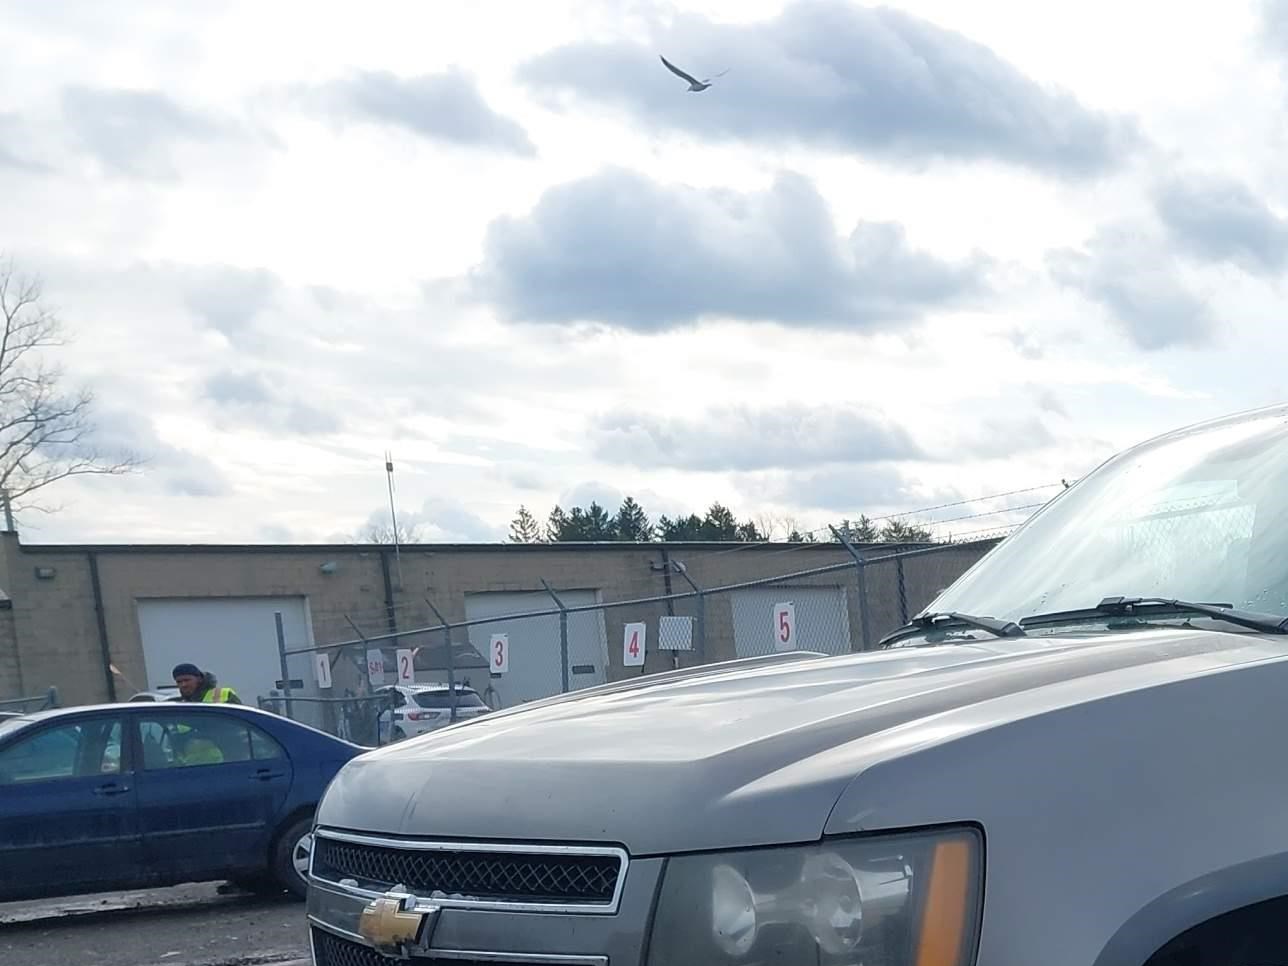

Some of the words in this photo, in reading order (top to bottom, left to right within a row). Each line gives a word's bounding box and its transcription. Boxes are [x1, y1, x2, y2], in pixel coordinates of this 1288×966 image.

[779, 611, 790, 643] 5
[494, 641, 504, 667] 3
[629, 631, 640, 658] 4
[320, 660, 327, 681] 1
[401, 656, 410, 679] 2
